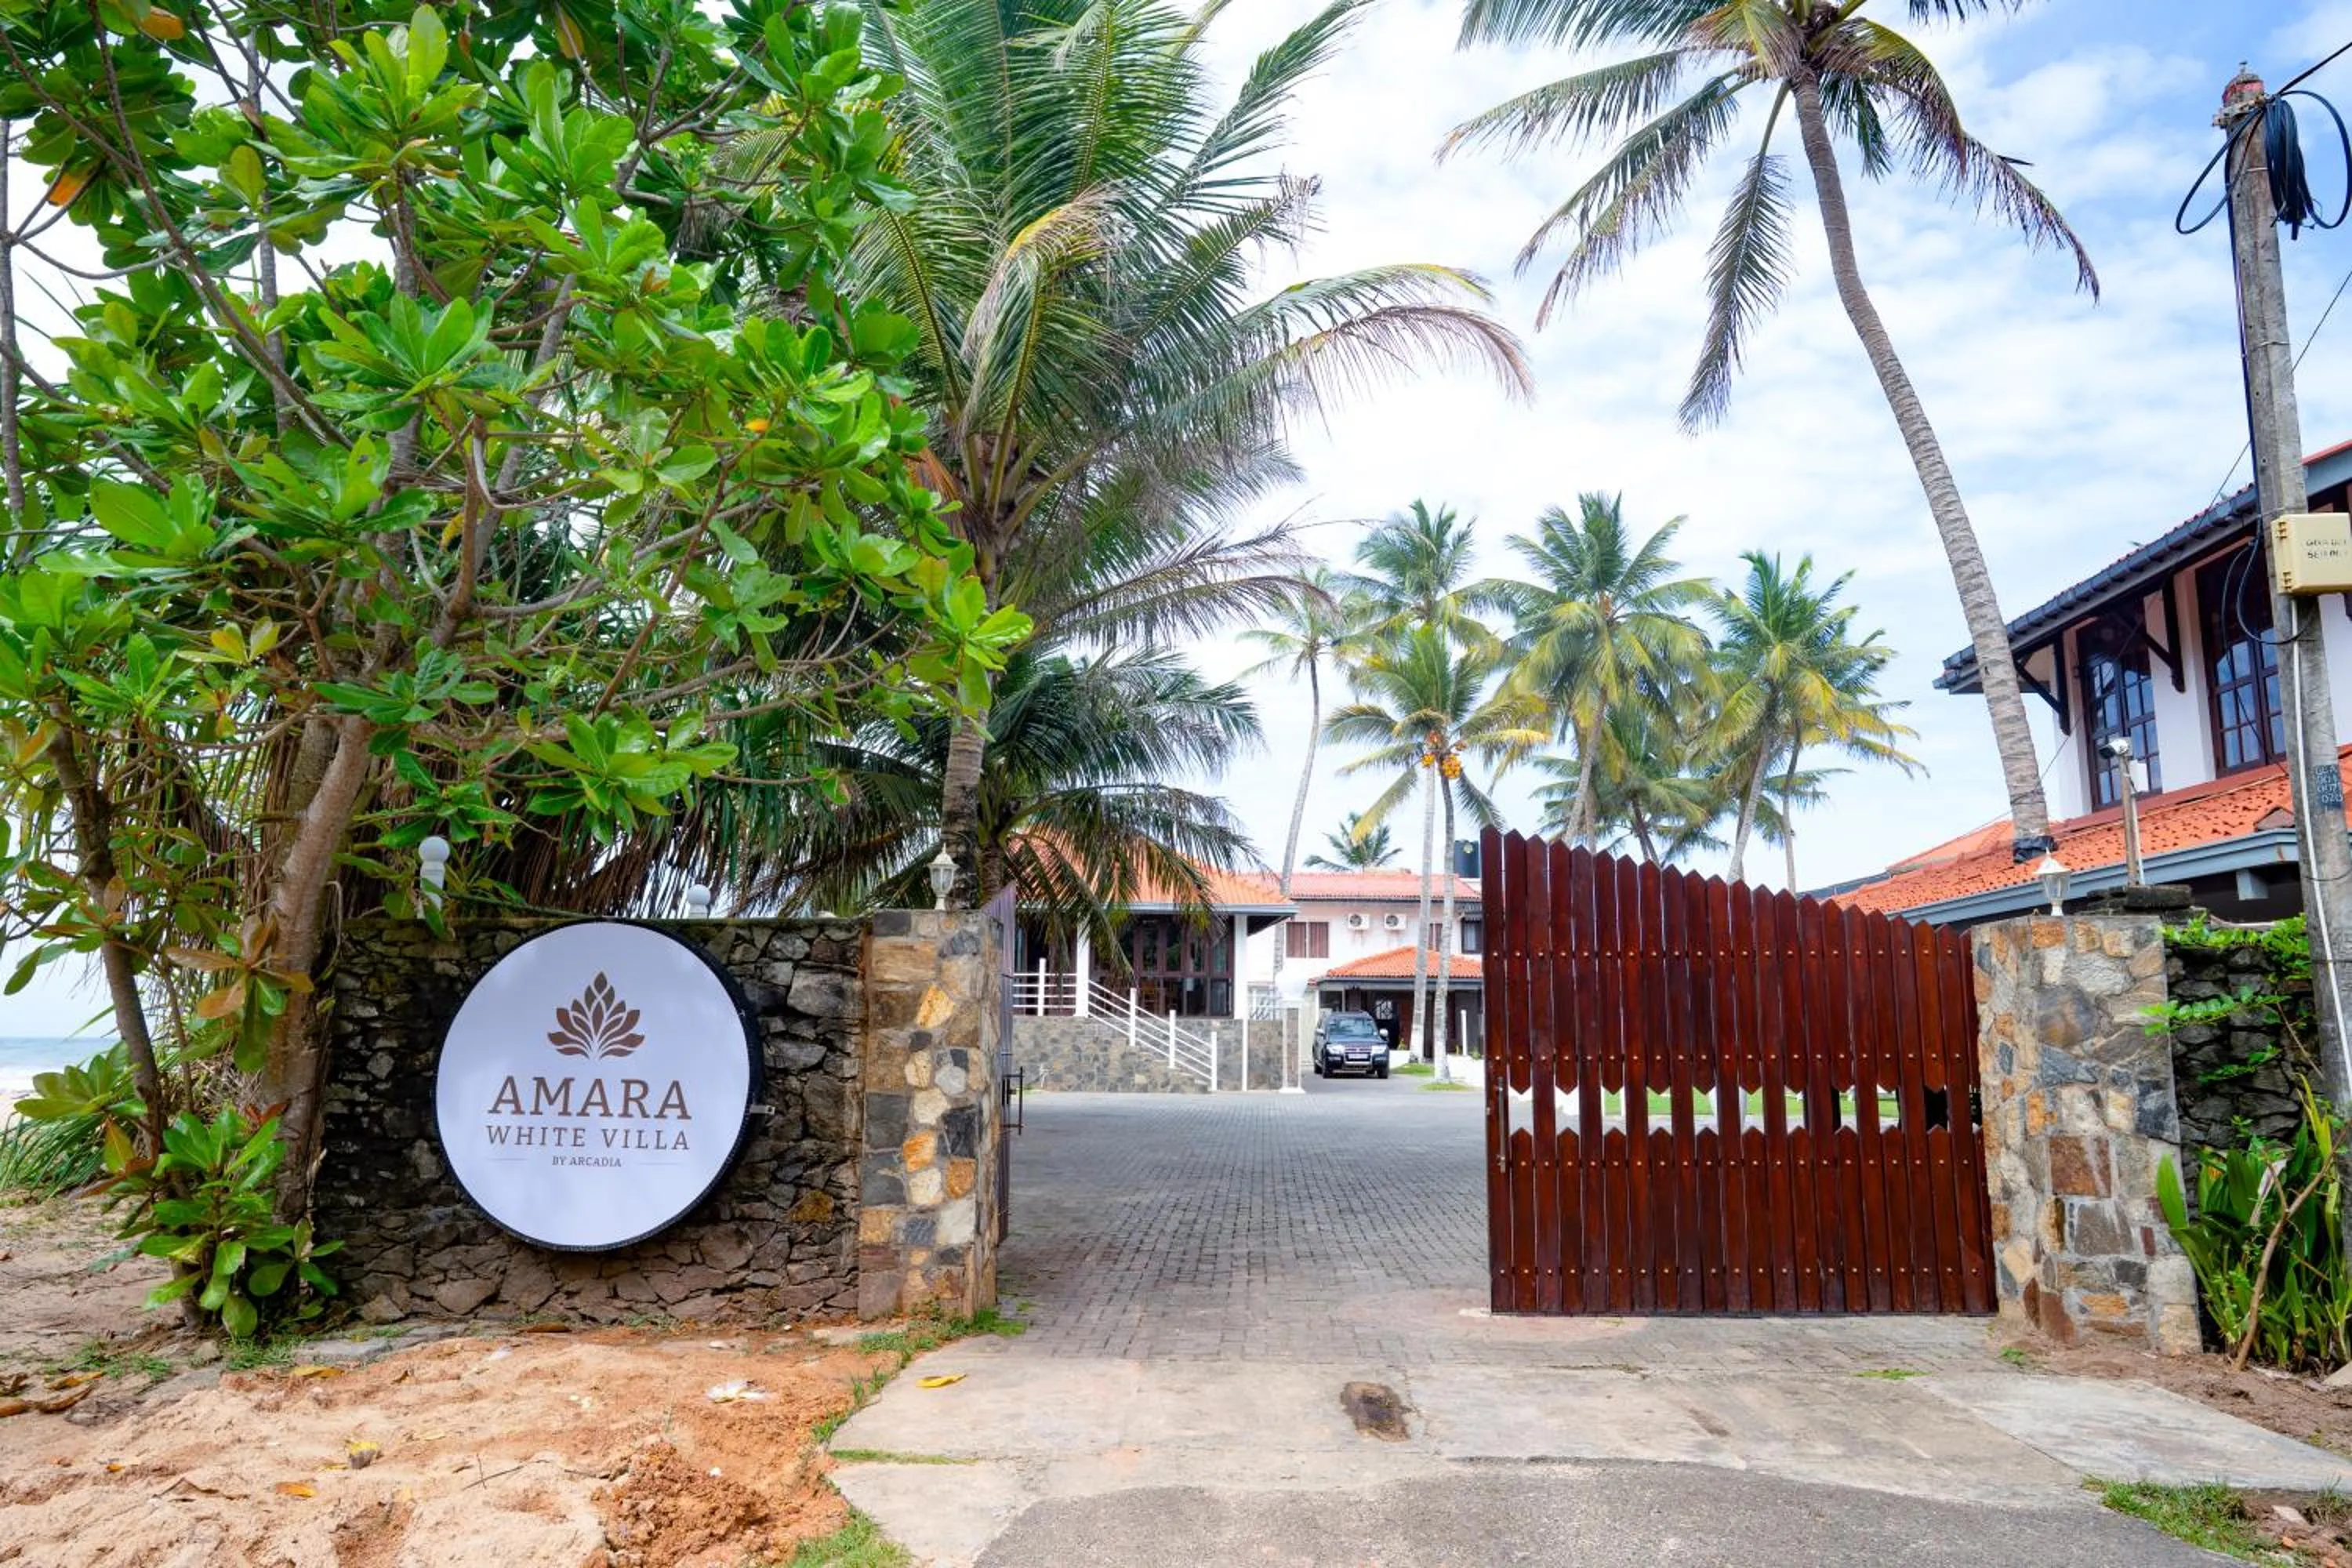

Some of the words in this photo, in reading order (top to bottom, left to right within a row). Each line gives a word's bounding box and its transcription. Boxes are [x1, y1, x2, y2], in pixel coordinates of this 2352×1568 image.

[488, 1075, 692, 1120] AMARA
[486, 1124, 586, 1148] WHITE
[601, 1128, 691, 1151] VILLA
[551, 1155, 565, 1167] BY
[568, 1156, 622, 1168] ARCADIA
